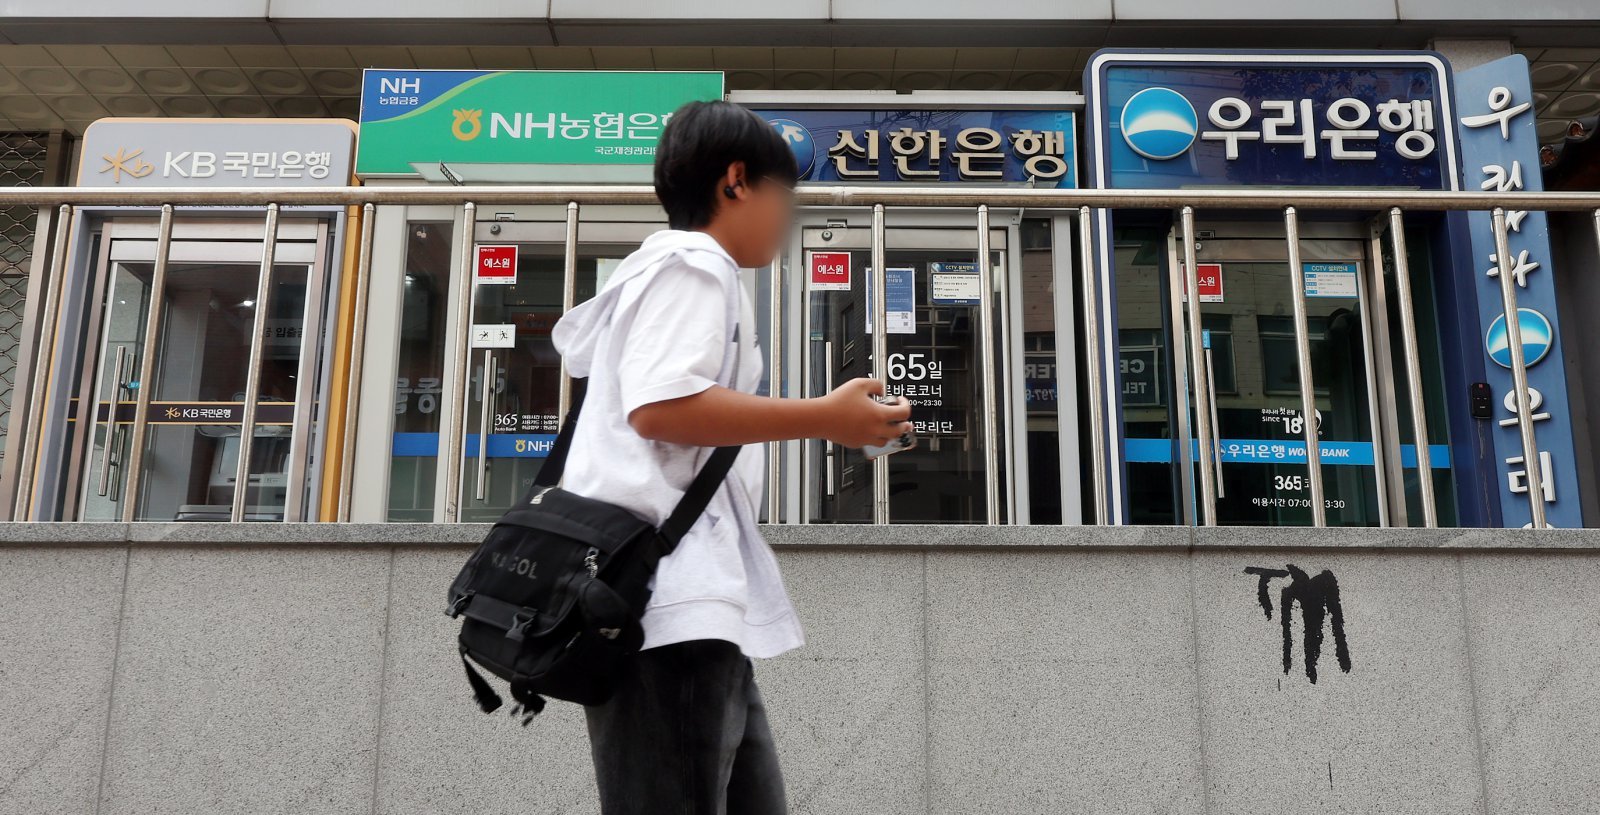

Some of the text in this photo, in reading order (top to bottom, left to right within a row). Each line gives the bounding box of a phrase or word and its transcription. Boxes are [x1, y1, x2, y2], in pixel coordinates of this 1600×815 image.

[380, 77, 420, 94] NH
[379, 96, 419, 105] 농협금융
[1201, 96, 1437, 160] 우리은행
[828, 127, 1068, 181] 신한은행
[483, 258, 510, 268] 에스원
[817, 264, 844, 275] 에스원
[1198, 276, 1216, 286] 스원
[867, 353, 943, 381] 65일
[494, 413, 518, 426] 365
[907, 421, 953, 433] 관리단
[1227, 444, 1285, 459] 우리은행
[1321, 448, 1350, 457] BANK
[1274, 475, 1302, 490] 365
[1252, 498, 1286, 508] 이용시간
